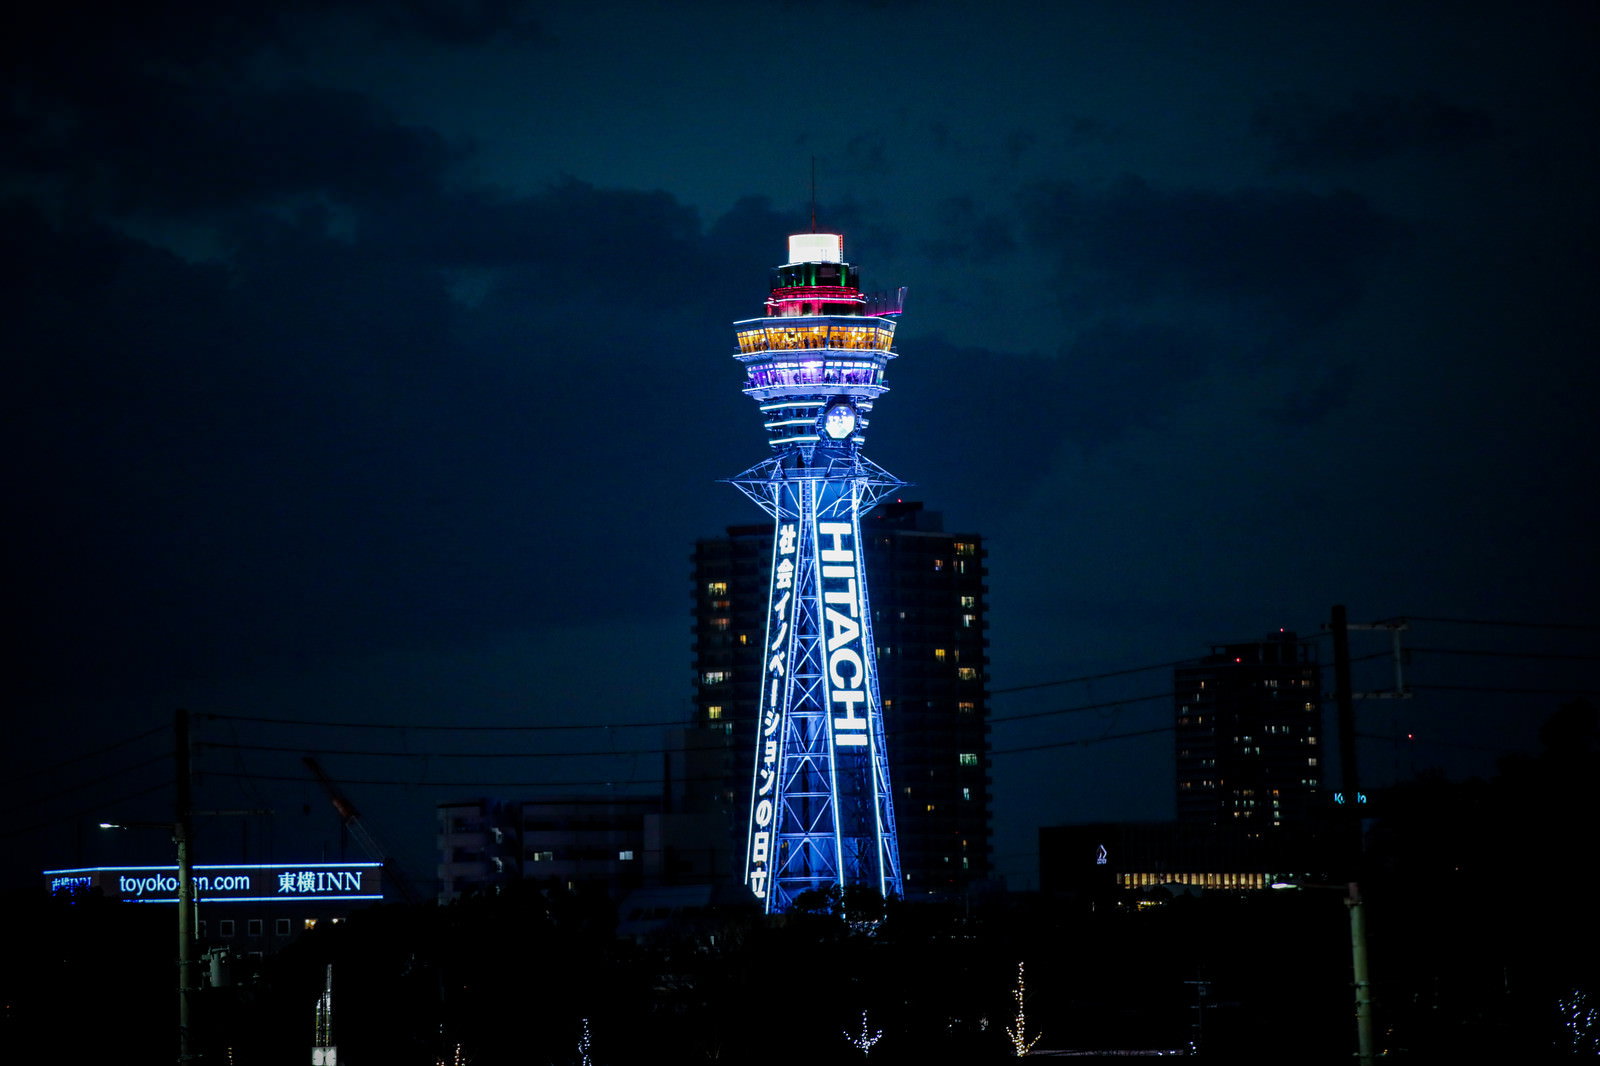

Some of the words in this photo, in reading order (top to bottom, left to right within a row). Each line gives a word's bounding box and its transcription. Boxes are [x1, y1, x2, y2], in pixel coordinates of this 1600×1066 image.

[819, 522, 868, 746] HITACHI
[750, 524, 797, 898] 社会イノベーションの日立
[119, 873, 250, 896] toyokonn.com
[278, 871, 362, 893] 東横INN
